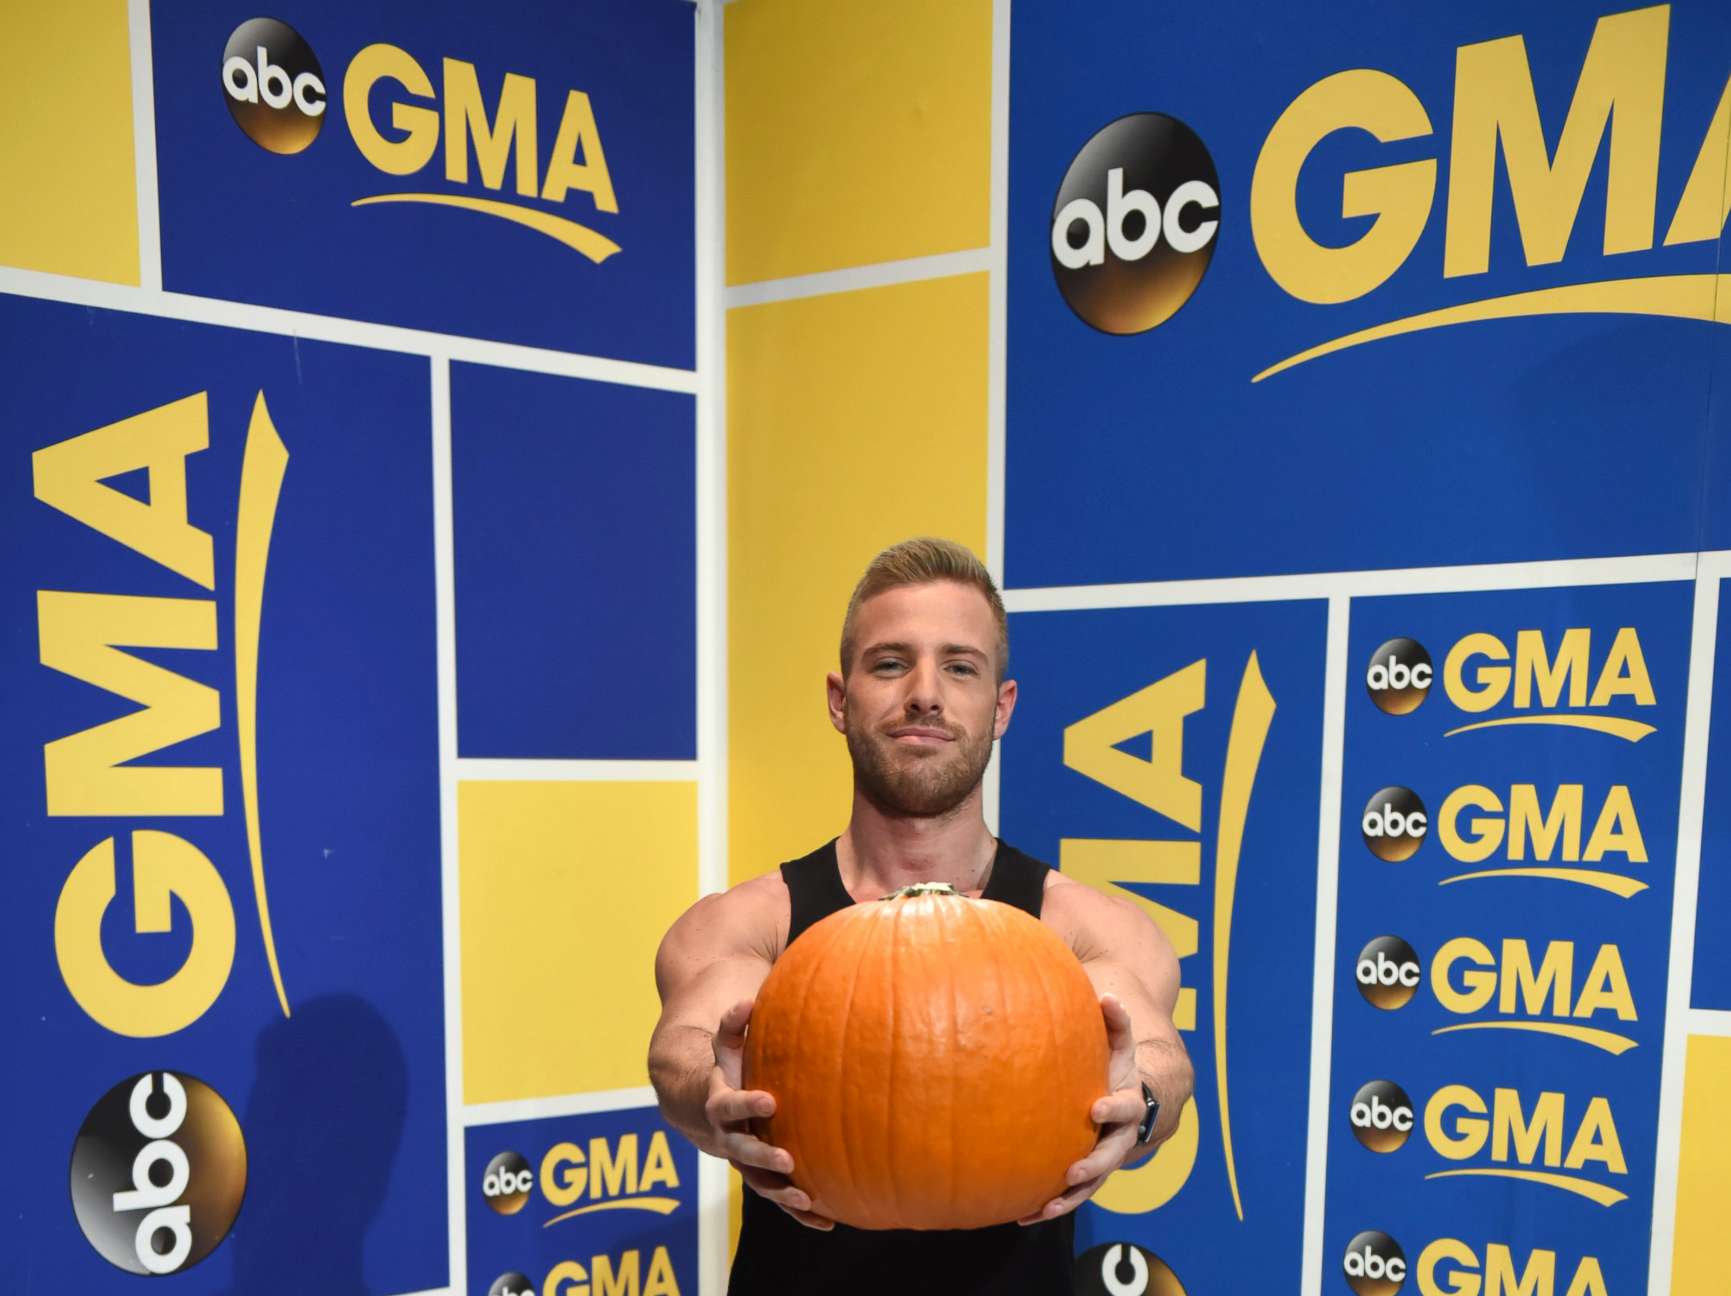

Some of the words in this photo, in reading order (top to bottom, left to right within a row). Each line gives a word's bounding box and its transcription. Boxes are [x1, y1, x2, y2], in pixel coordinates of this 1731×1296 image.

[223, 45, 327, 117] abc
[344, 44, 618, 213] GMA
[1051, 168, 1220, 269] abc
[1367, 655, 1433, 691] abc
[1444, 627, 1655, 712] GMA
[32, 391, 237, 1038] GMA
[1362, 804, 1427, 839] abc
[1438, 784, 1649, 862] GMA
[1356, 952, 1421, 988] abc
[1431, 937, 1638, 1022] GMA
[113, 1072, 193, 1274] abc
[483, 1165, 534, 1197] abc
[540, 1131, 680, 1207] GMA
[1350, 1097, 1413, 1133] abc
[1424, 1085, 1628, 1174] GMA
[1343, 1246, 1406, 1283] abc
